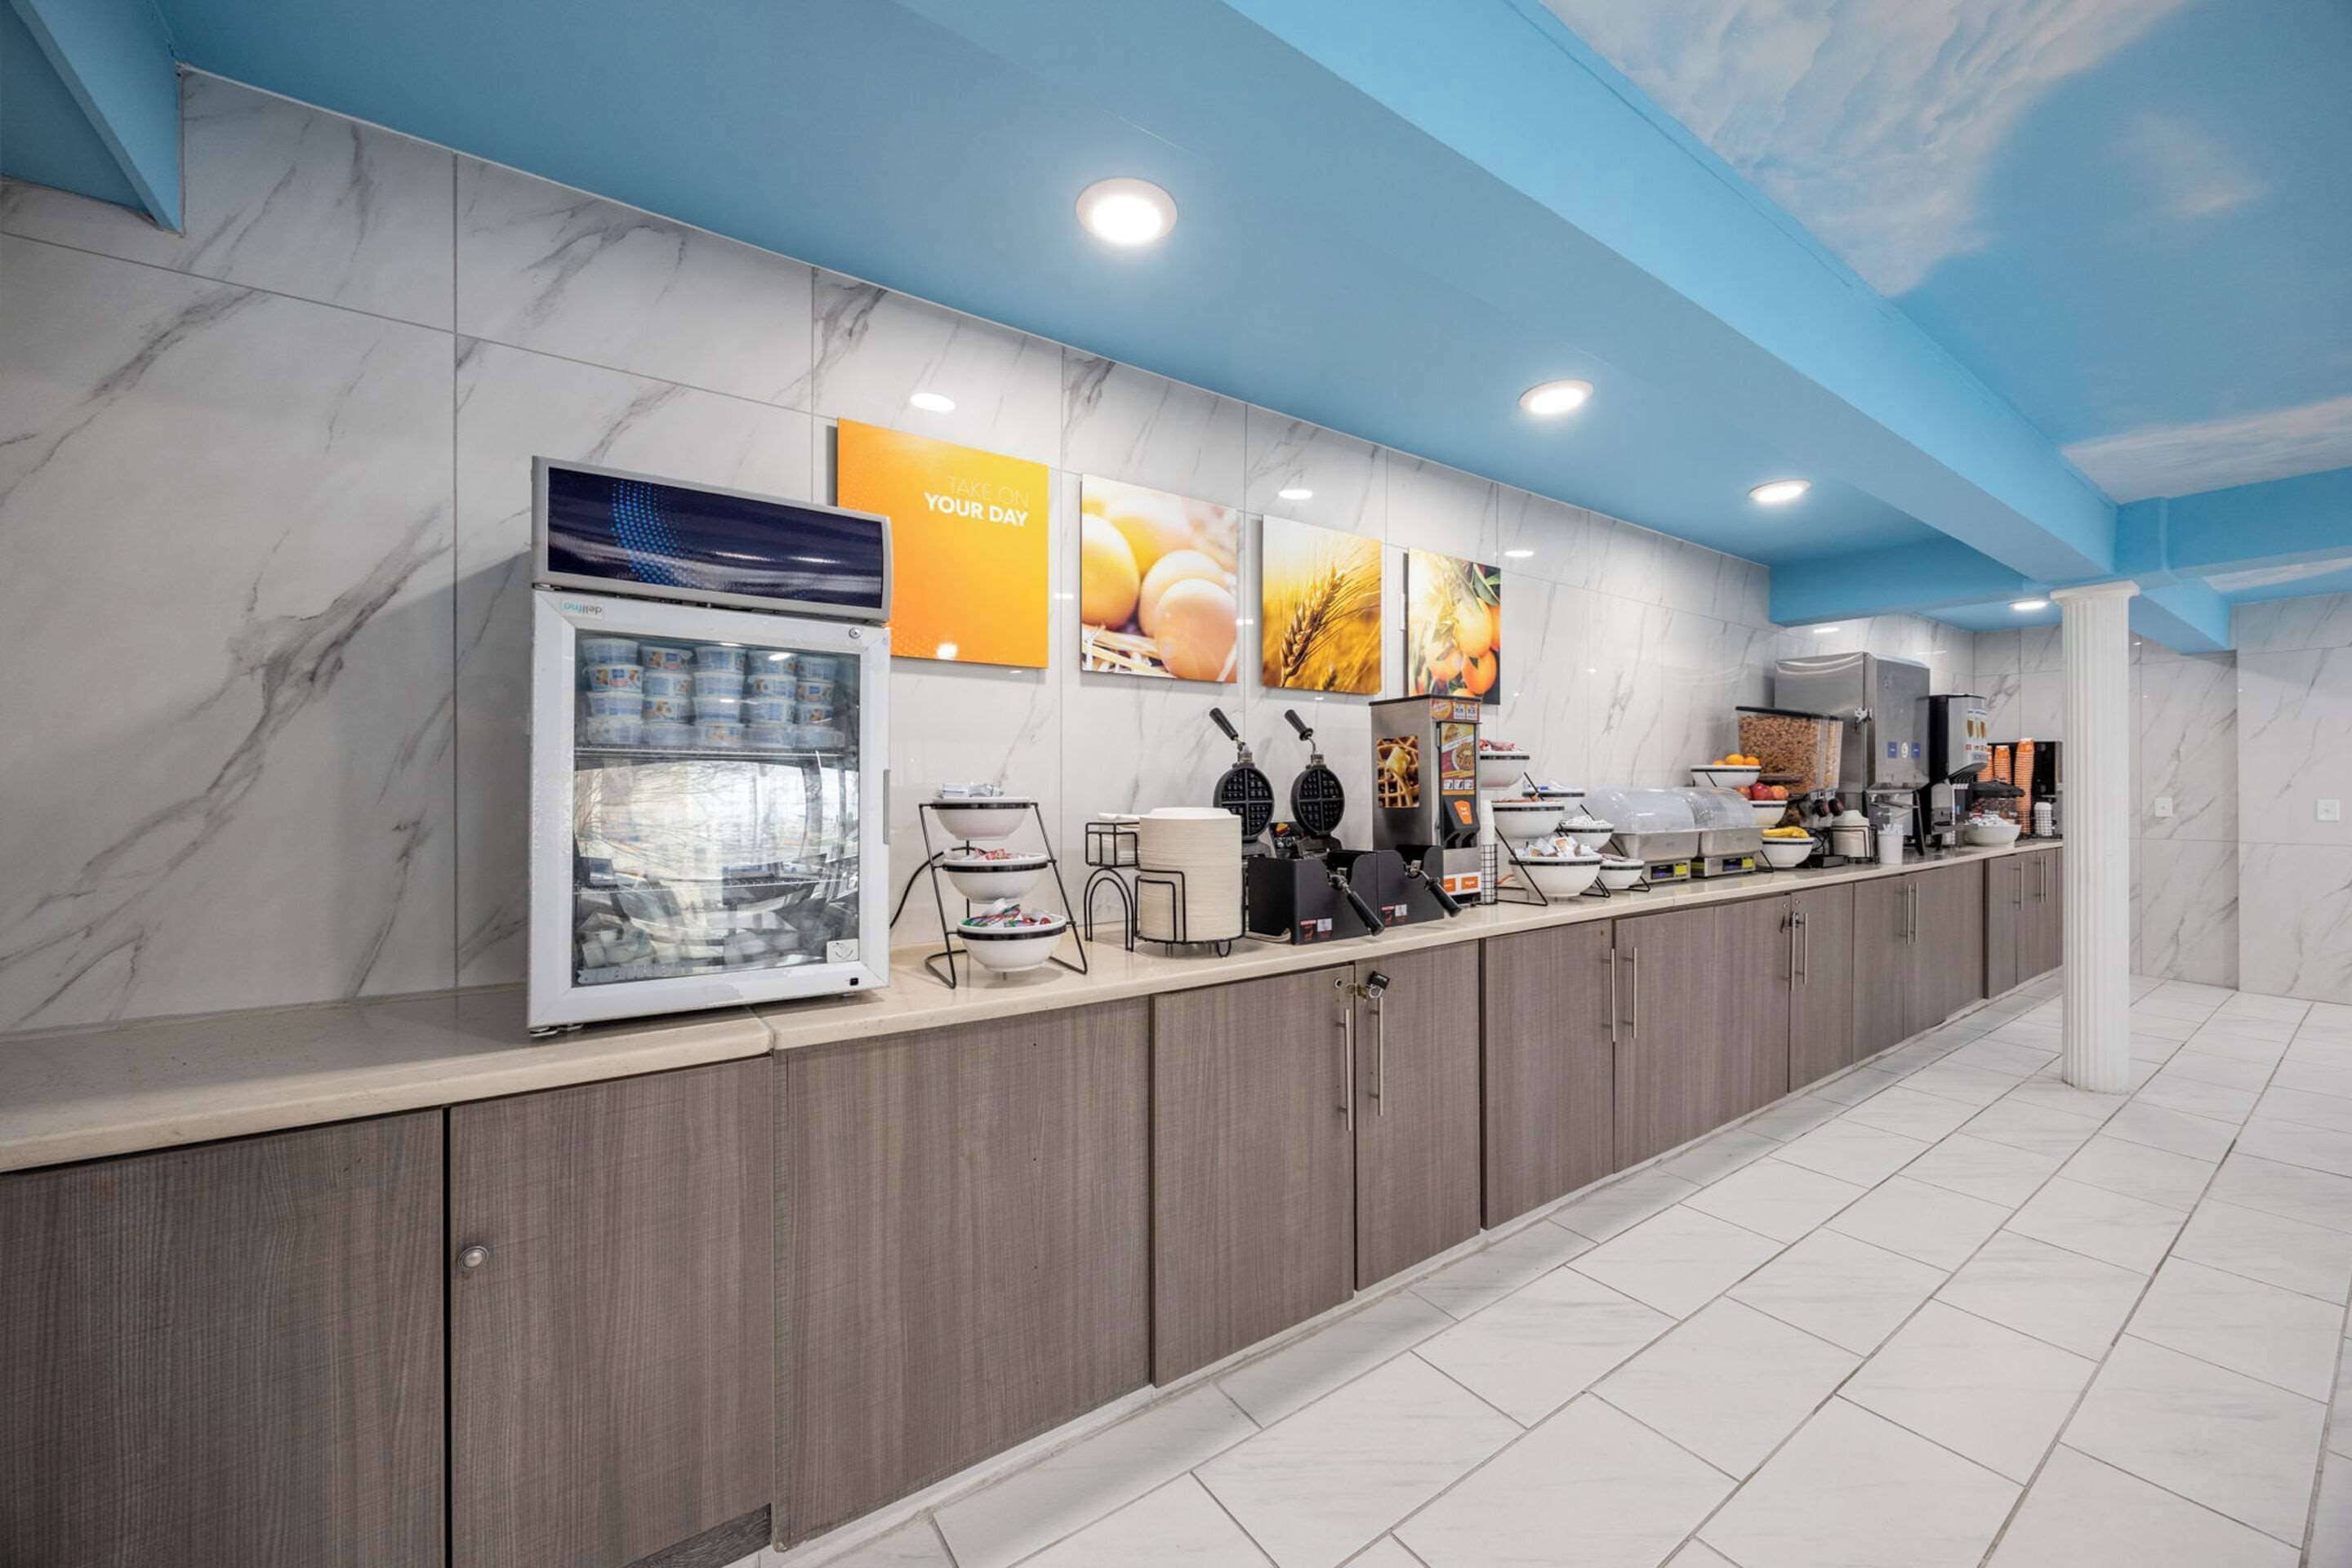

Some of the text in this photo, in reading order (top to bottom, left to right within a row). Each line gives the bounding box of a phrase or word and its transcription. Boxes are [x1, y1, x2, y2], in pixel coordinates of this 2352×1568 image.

[948, 476, 1029, 506] TAKE ON
[924, 492, 1029, 527] YOUR DAY
